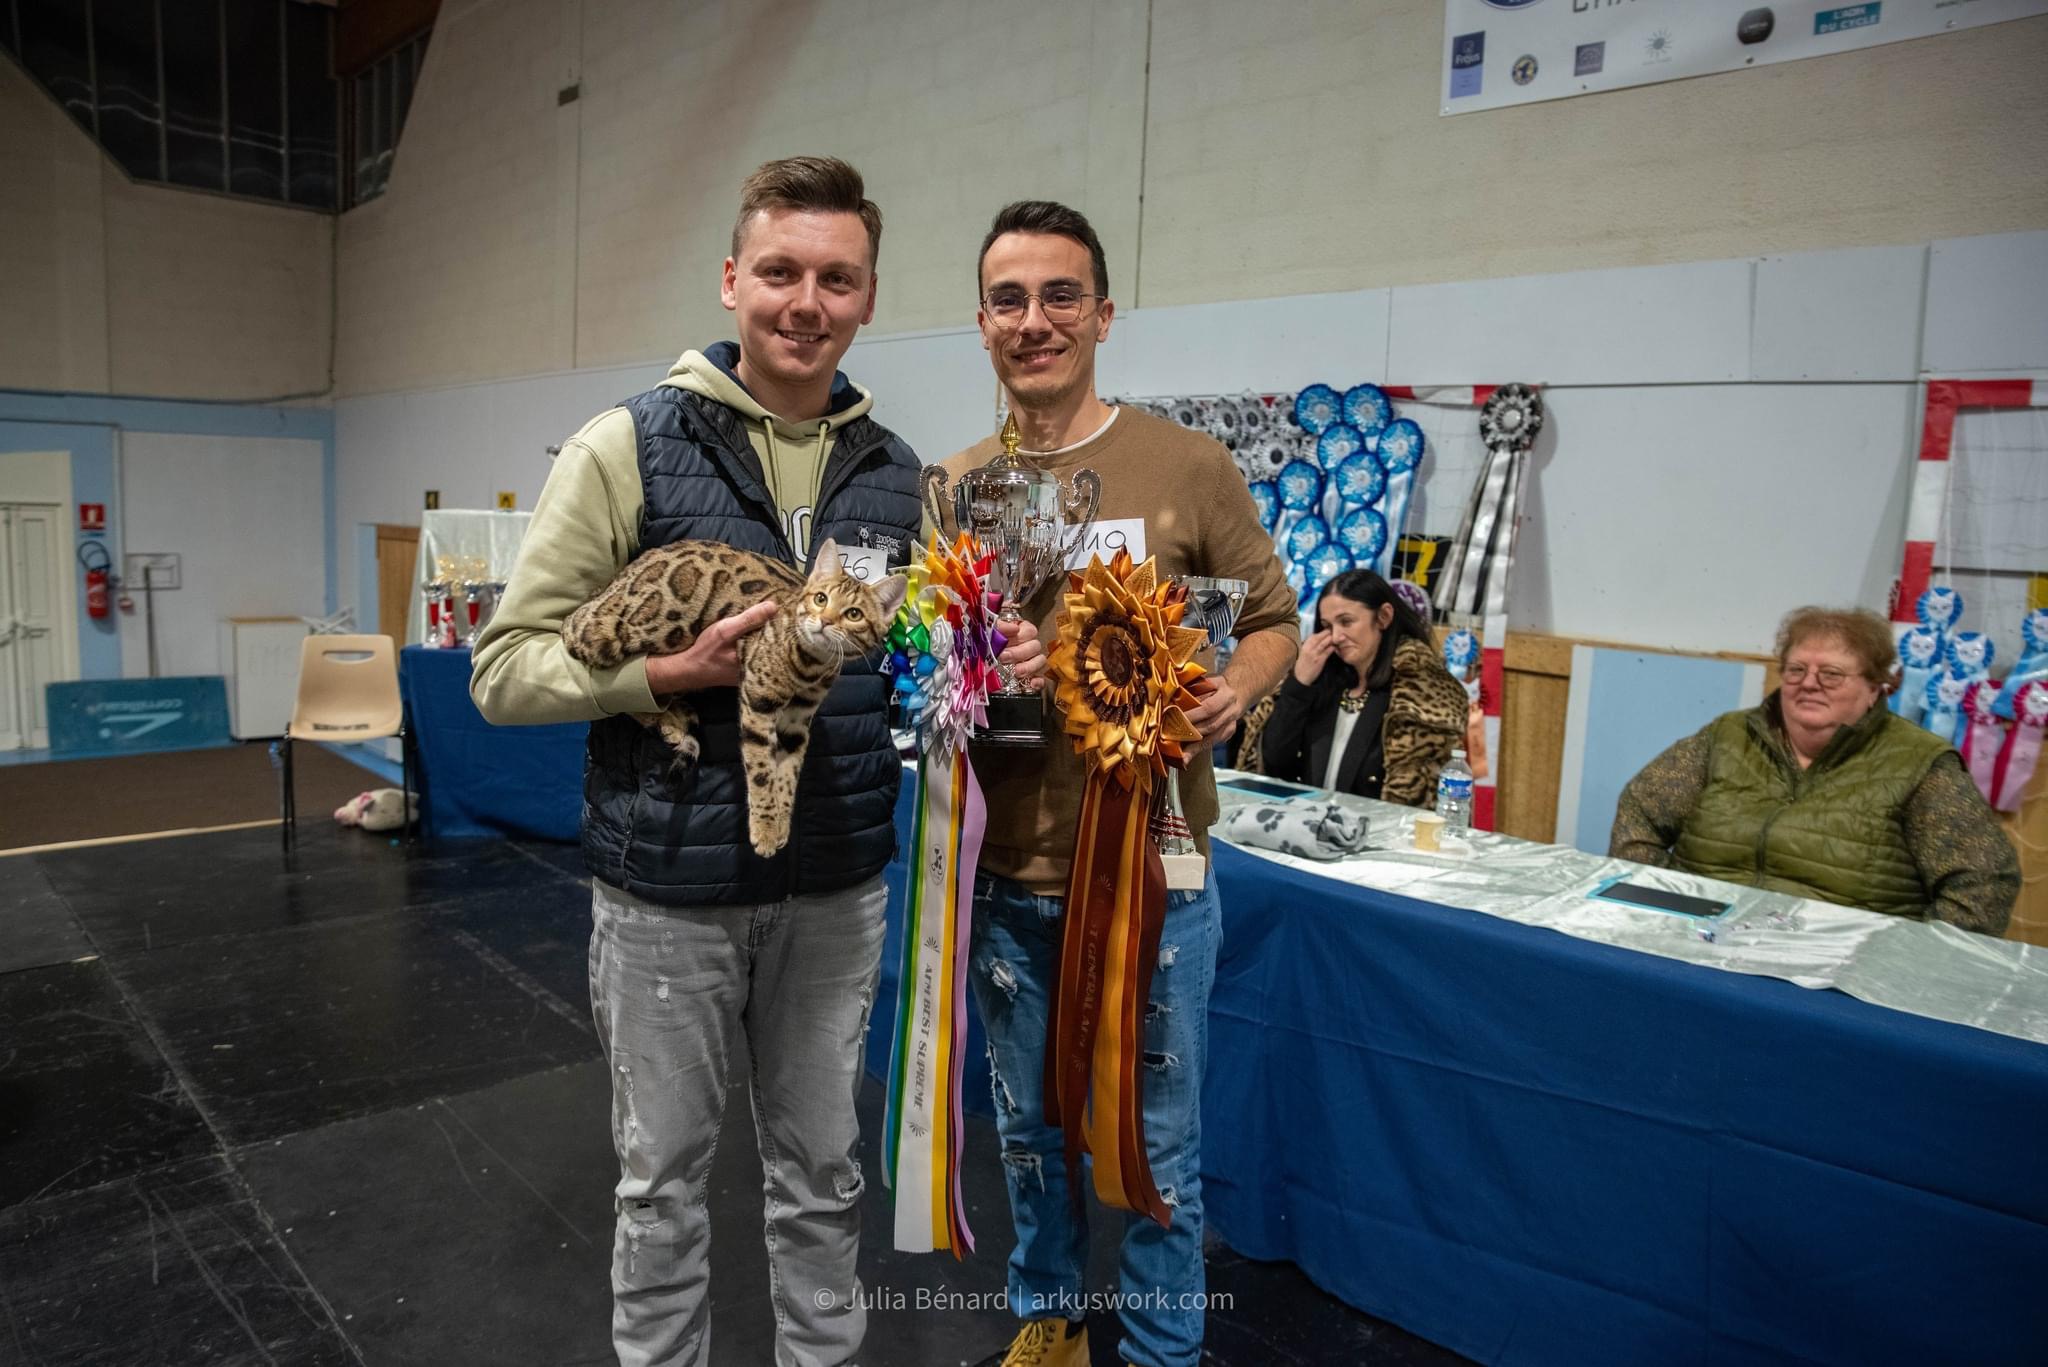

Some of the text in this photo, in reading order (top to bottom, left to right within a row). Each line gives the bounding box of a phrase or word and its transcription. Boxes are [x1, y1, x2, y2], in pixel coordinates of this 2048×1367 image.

[1819, 14, 1878, 33] DU CYCLE
[921, 997, 932, 1039] BEST
[913, 1040, 929, 1112] SUPREME
